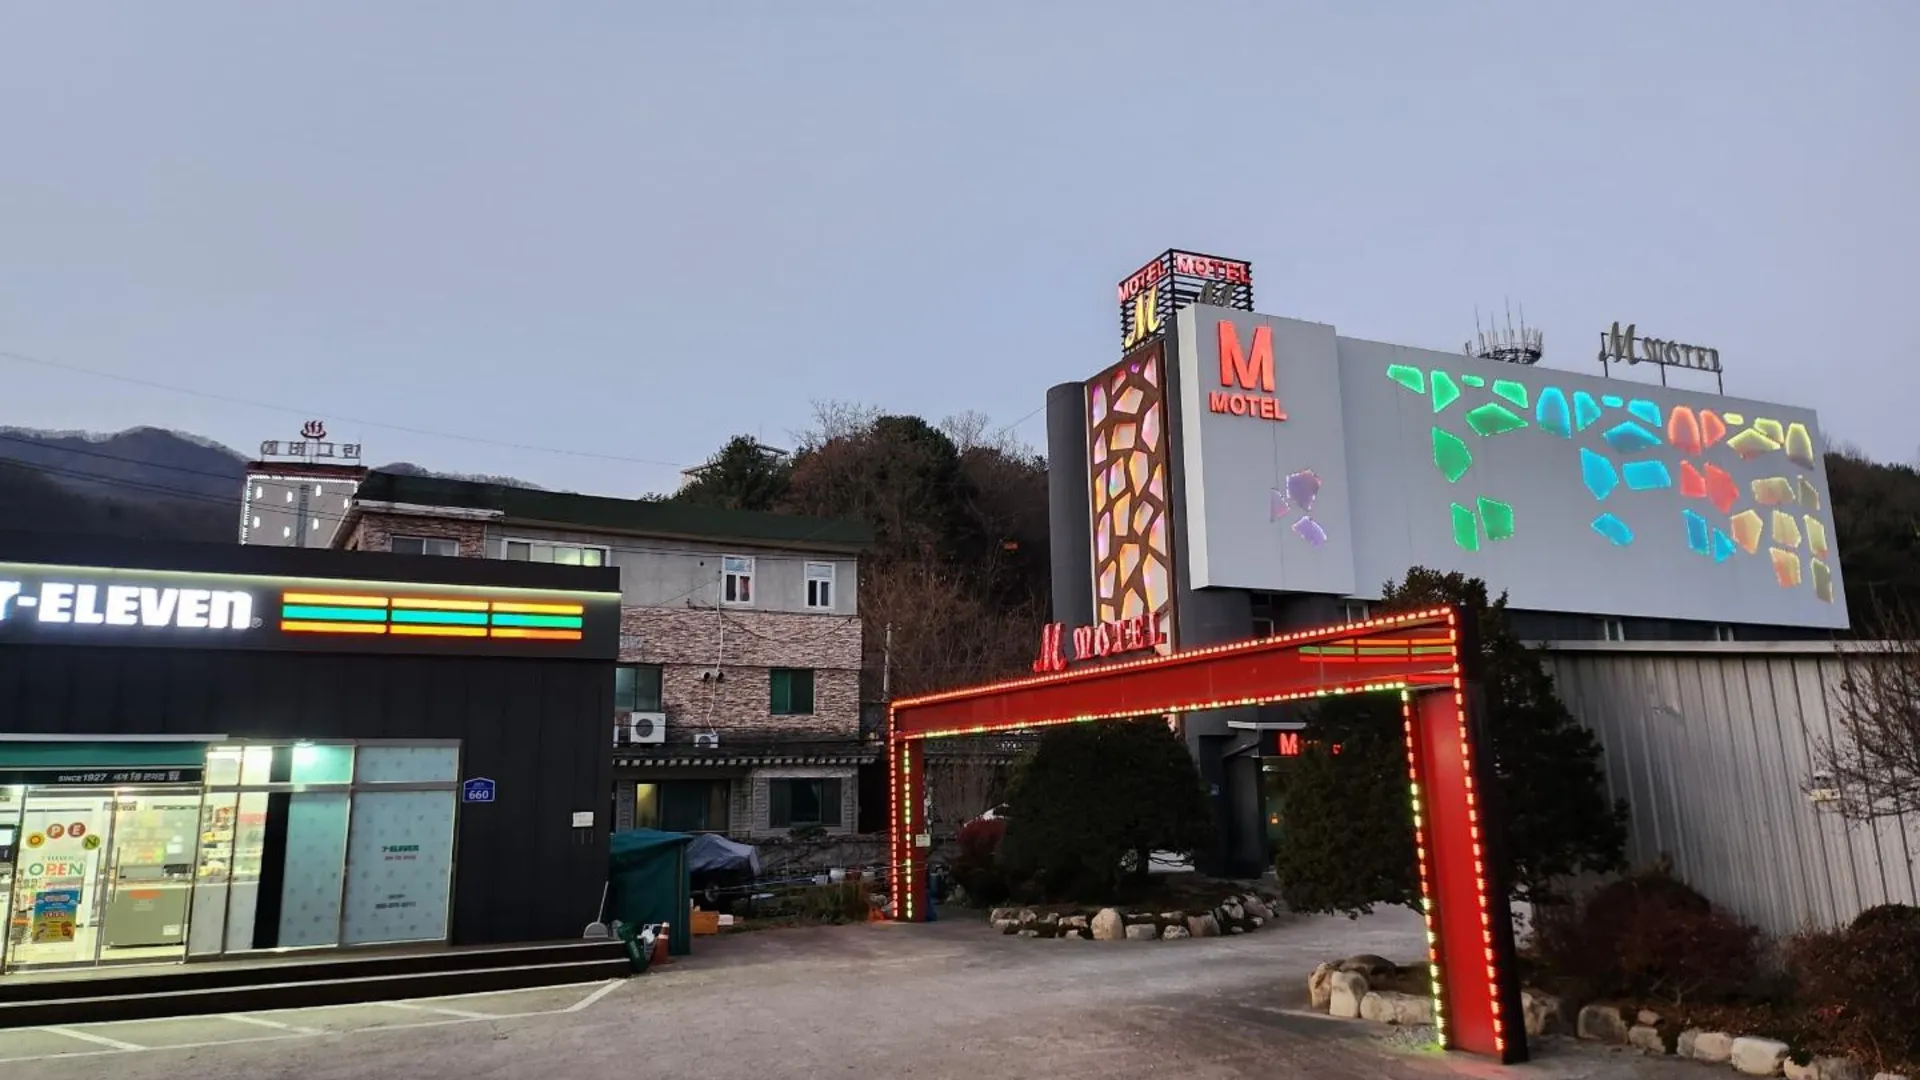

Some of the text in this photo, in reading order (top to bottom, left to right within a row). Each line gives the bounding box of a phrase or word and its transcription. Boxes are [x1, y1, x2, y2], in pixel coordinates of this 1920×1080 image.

[1117, 260, 1168, 302] MOTEL
[1175, 254, 1252, 284] MOTEL
[1124, 284, 1162, 348] M
[1218, 320, 1276, 392] M
[1599, 321, 1721, 373] M MOTEL
[1208, 390, 1288, 422] MOTEL
[1033, 611, 1168, 672] M MOTEL
[468, 790, 489, 800] 660
[28, 862, 84, 876] OPEN
